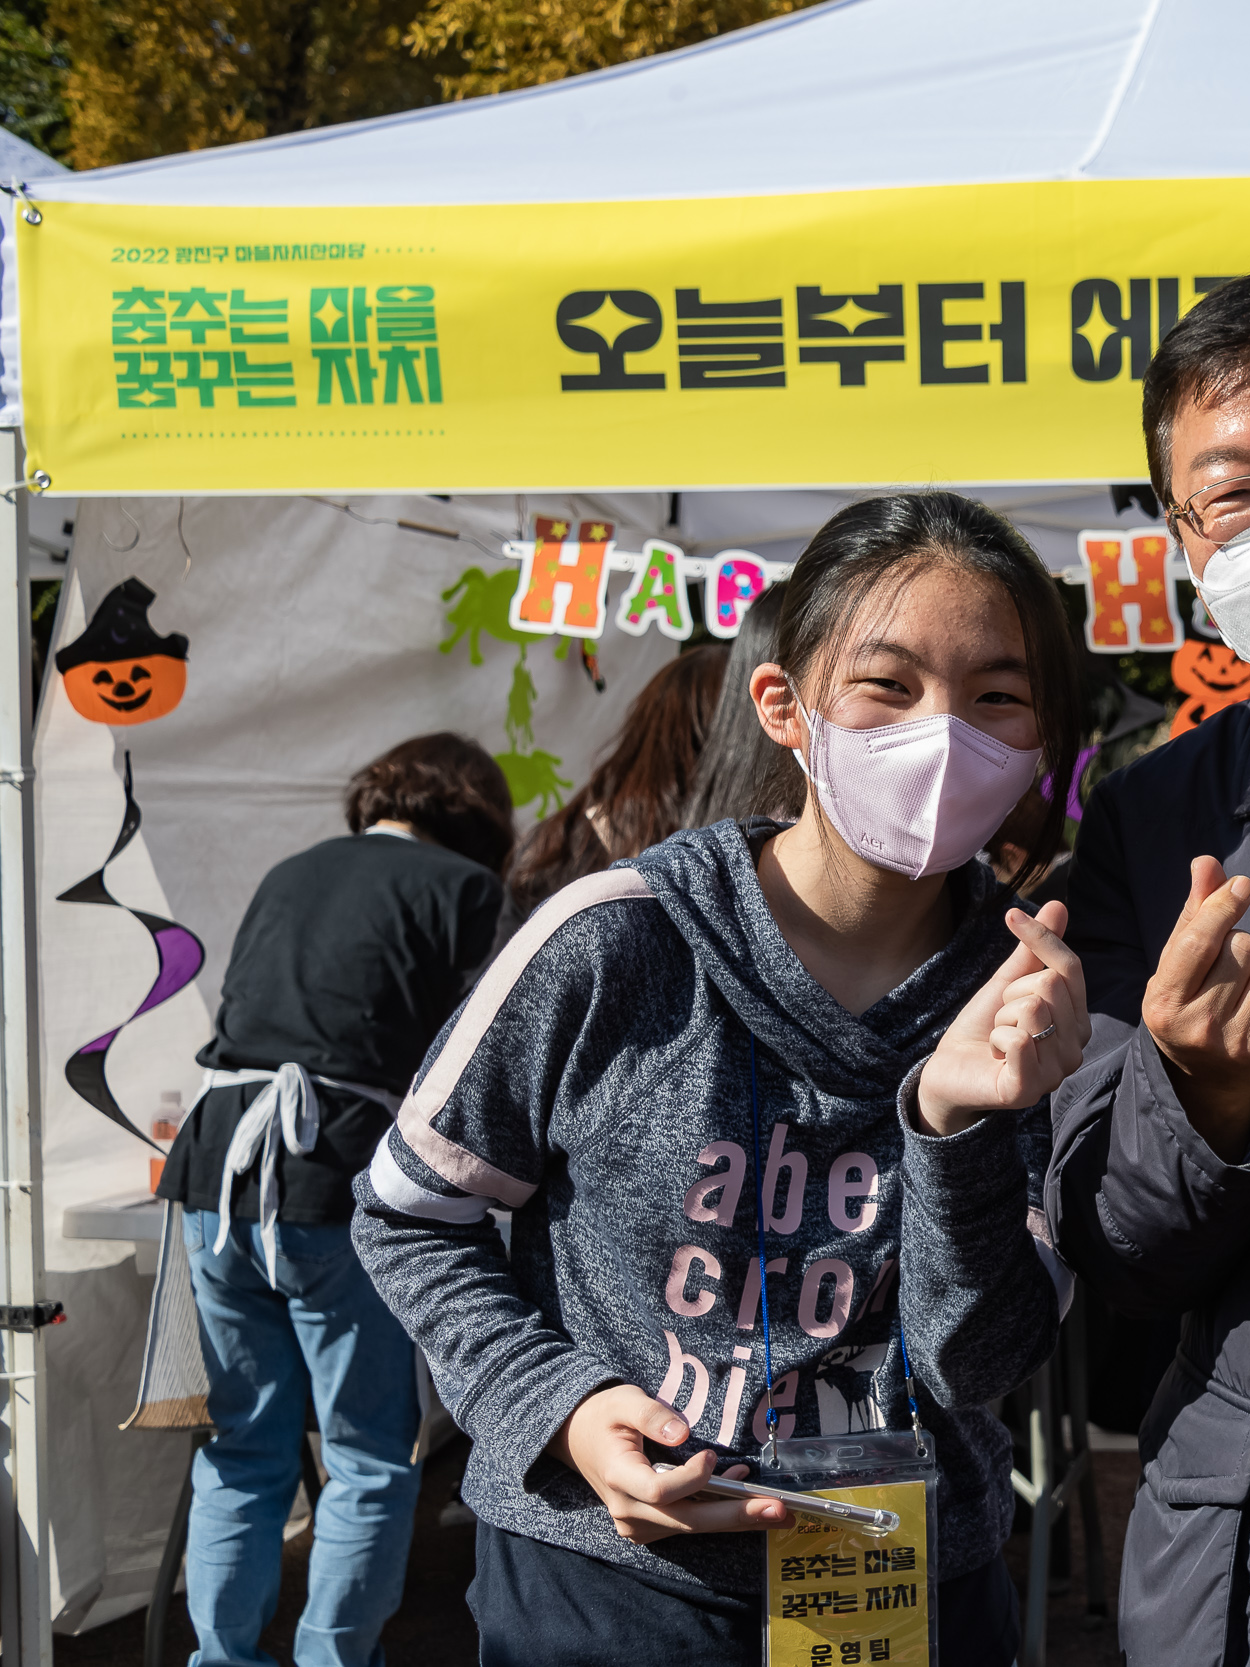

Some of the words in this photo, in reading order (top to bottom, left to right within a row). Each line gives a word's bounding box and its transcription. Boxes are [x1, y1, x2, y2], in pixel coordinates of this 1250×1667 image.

[111, 247, 170, 264] 2022
[175, 245, 229, 264] 광진구
[112, 286, 290, 345] 춤추는
[310, 284, 438, 344] 마을
[556, 281, 1028, 392] 오늘부터
[113, 351, 298, 409] 꿈꾸는
[311, 343, 444, 406] 자치
[780, 1553, 857, 1582] 춤추는
[864, 1546, 916, 1575] 마을
[781, 1590, 858, 1619] 꿈꾸는
[865, 1583, 917, 1612] 자치
